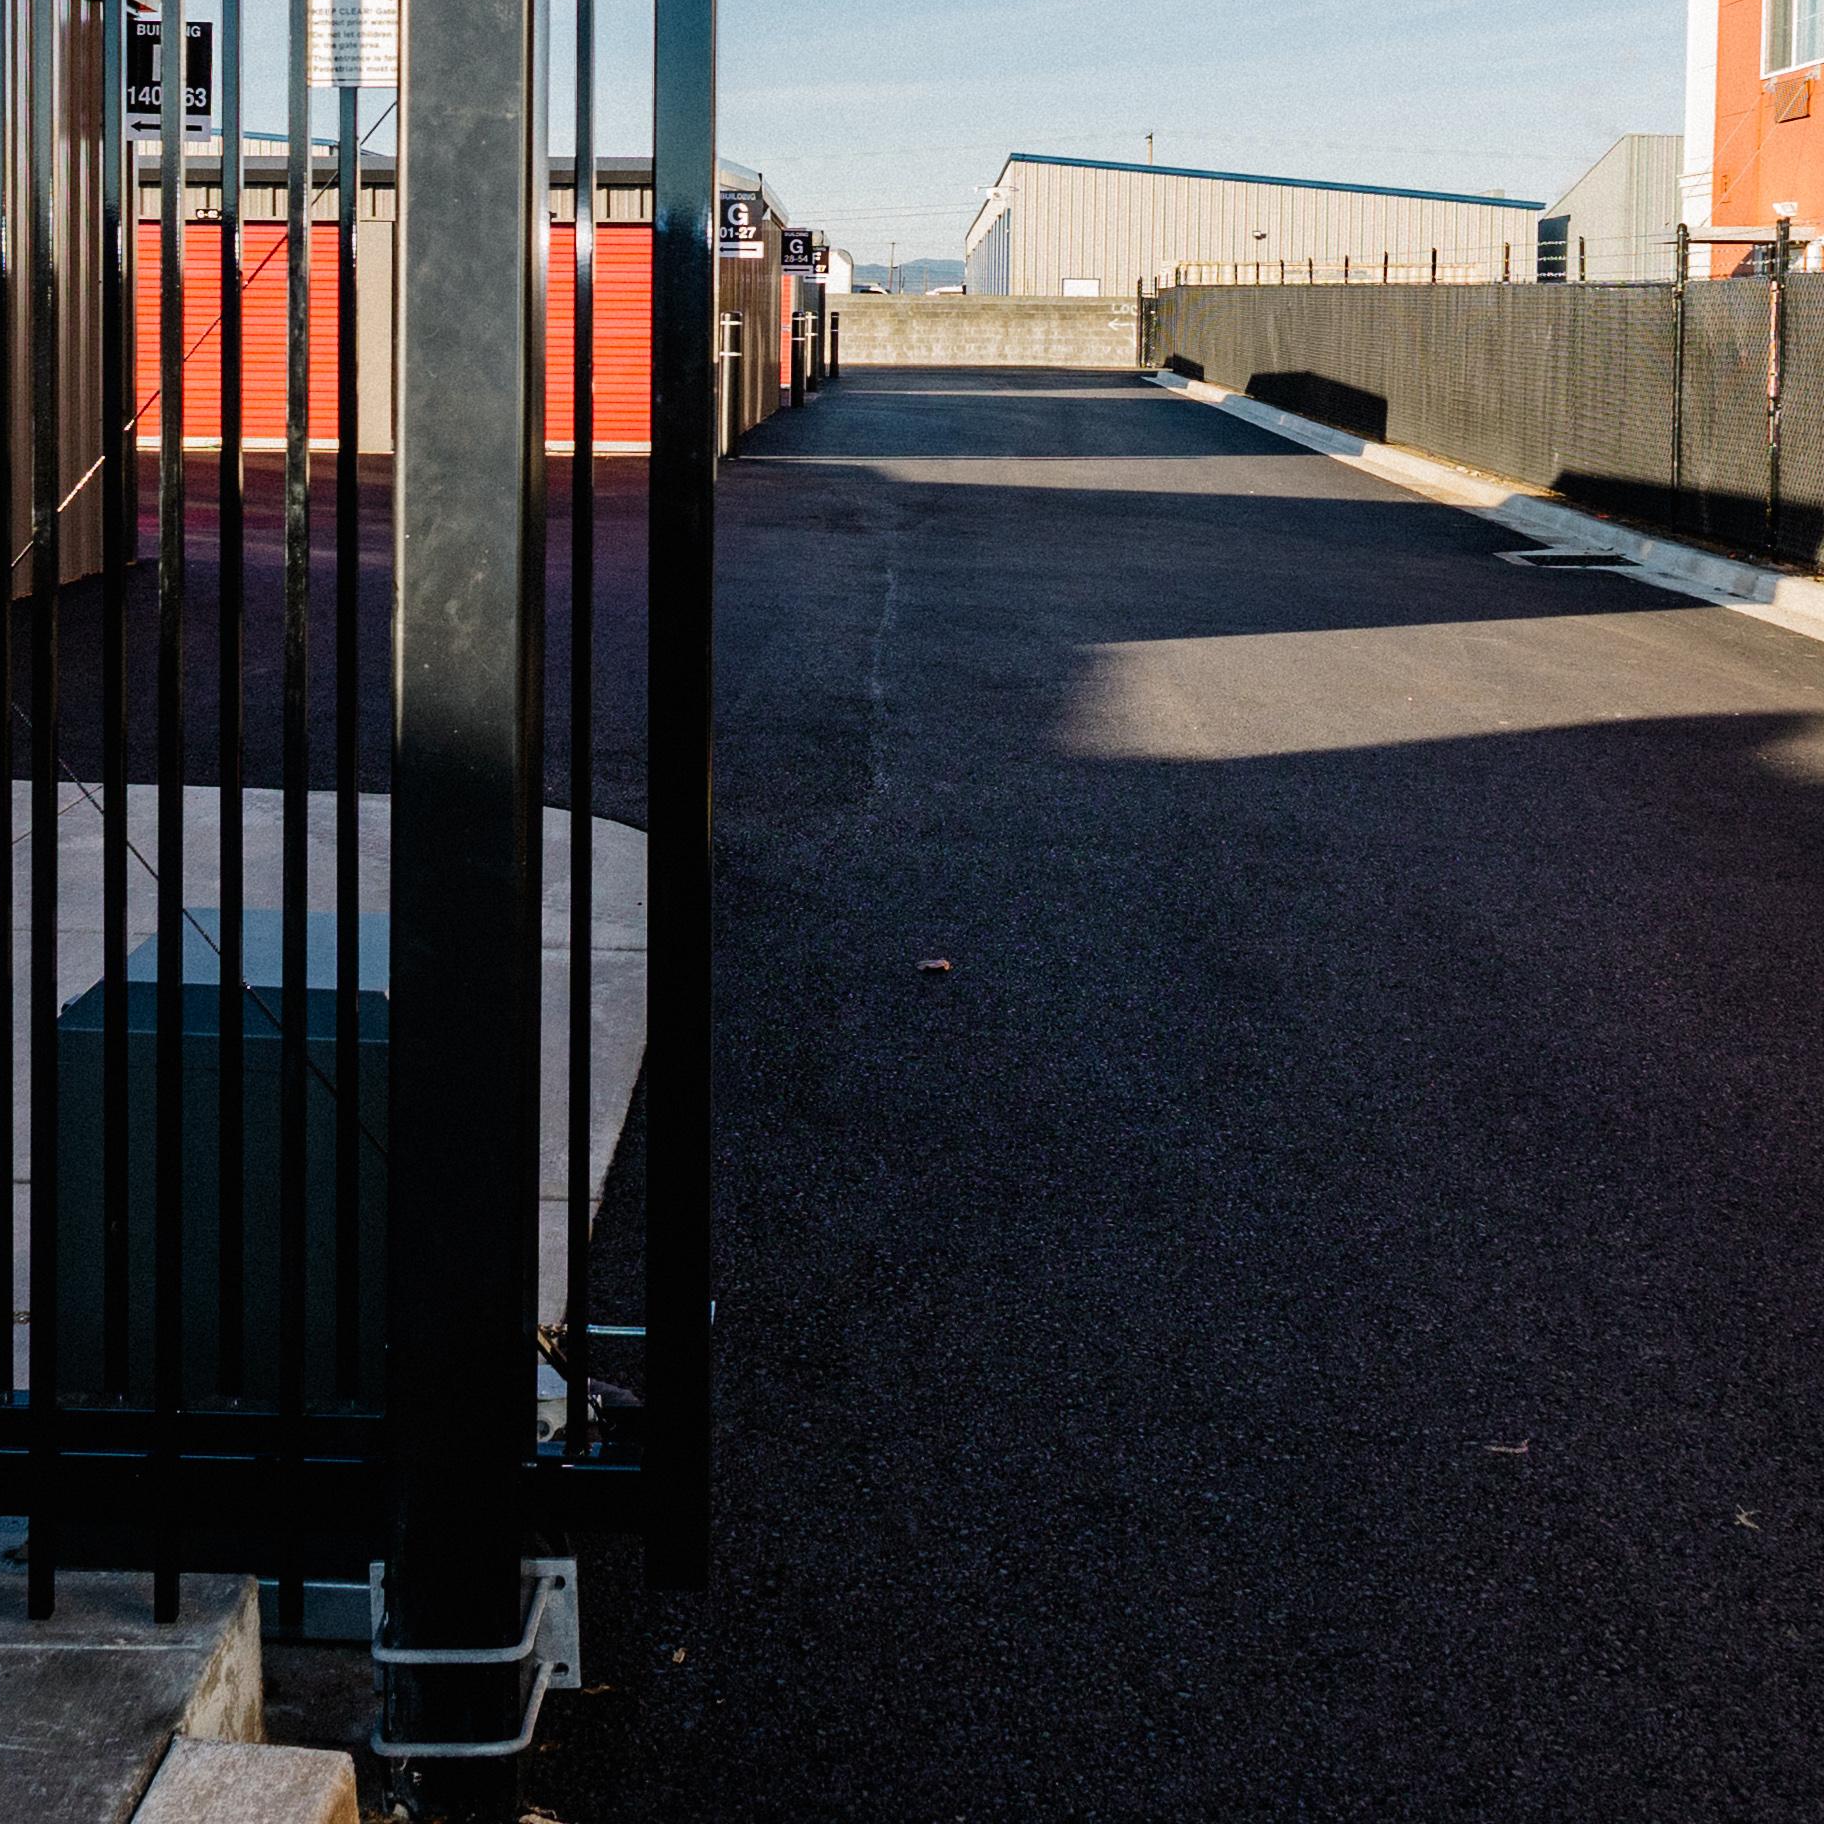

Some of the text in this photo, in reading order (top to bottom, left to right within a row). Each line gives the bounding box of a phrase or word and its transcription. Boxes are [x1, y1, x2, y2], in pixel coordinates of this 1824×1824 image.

[136, 23, 201, 37] BUIG
[127, 85, 207, 107] 14063
[727, 202, 749, 226] G
[719, 226, 757, 239] 01-27
[789, 238, 804, 254] G
